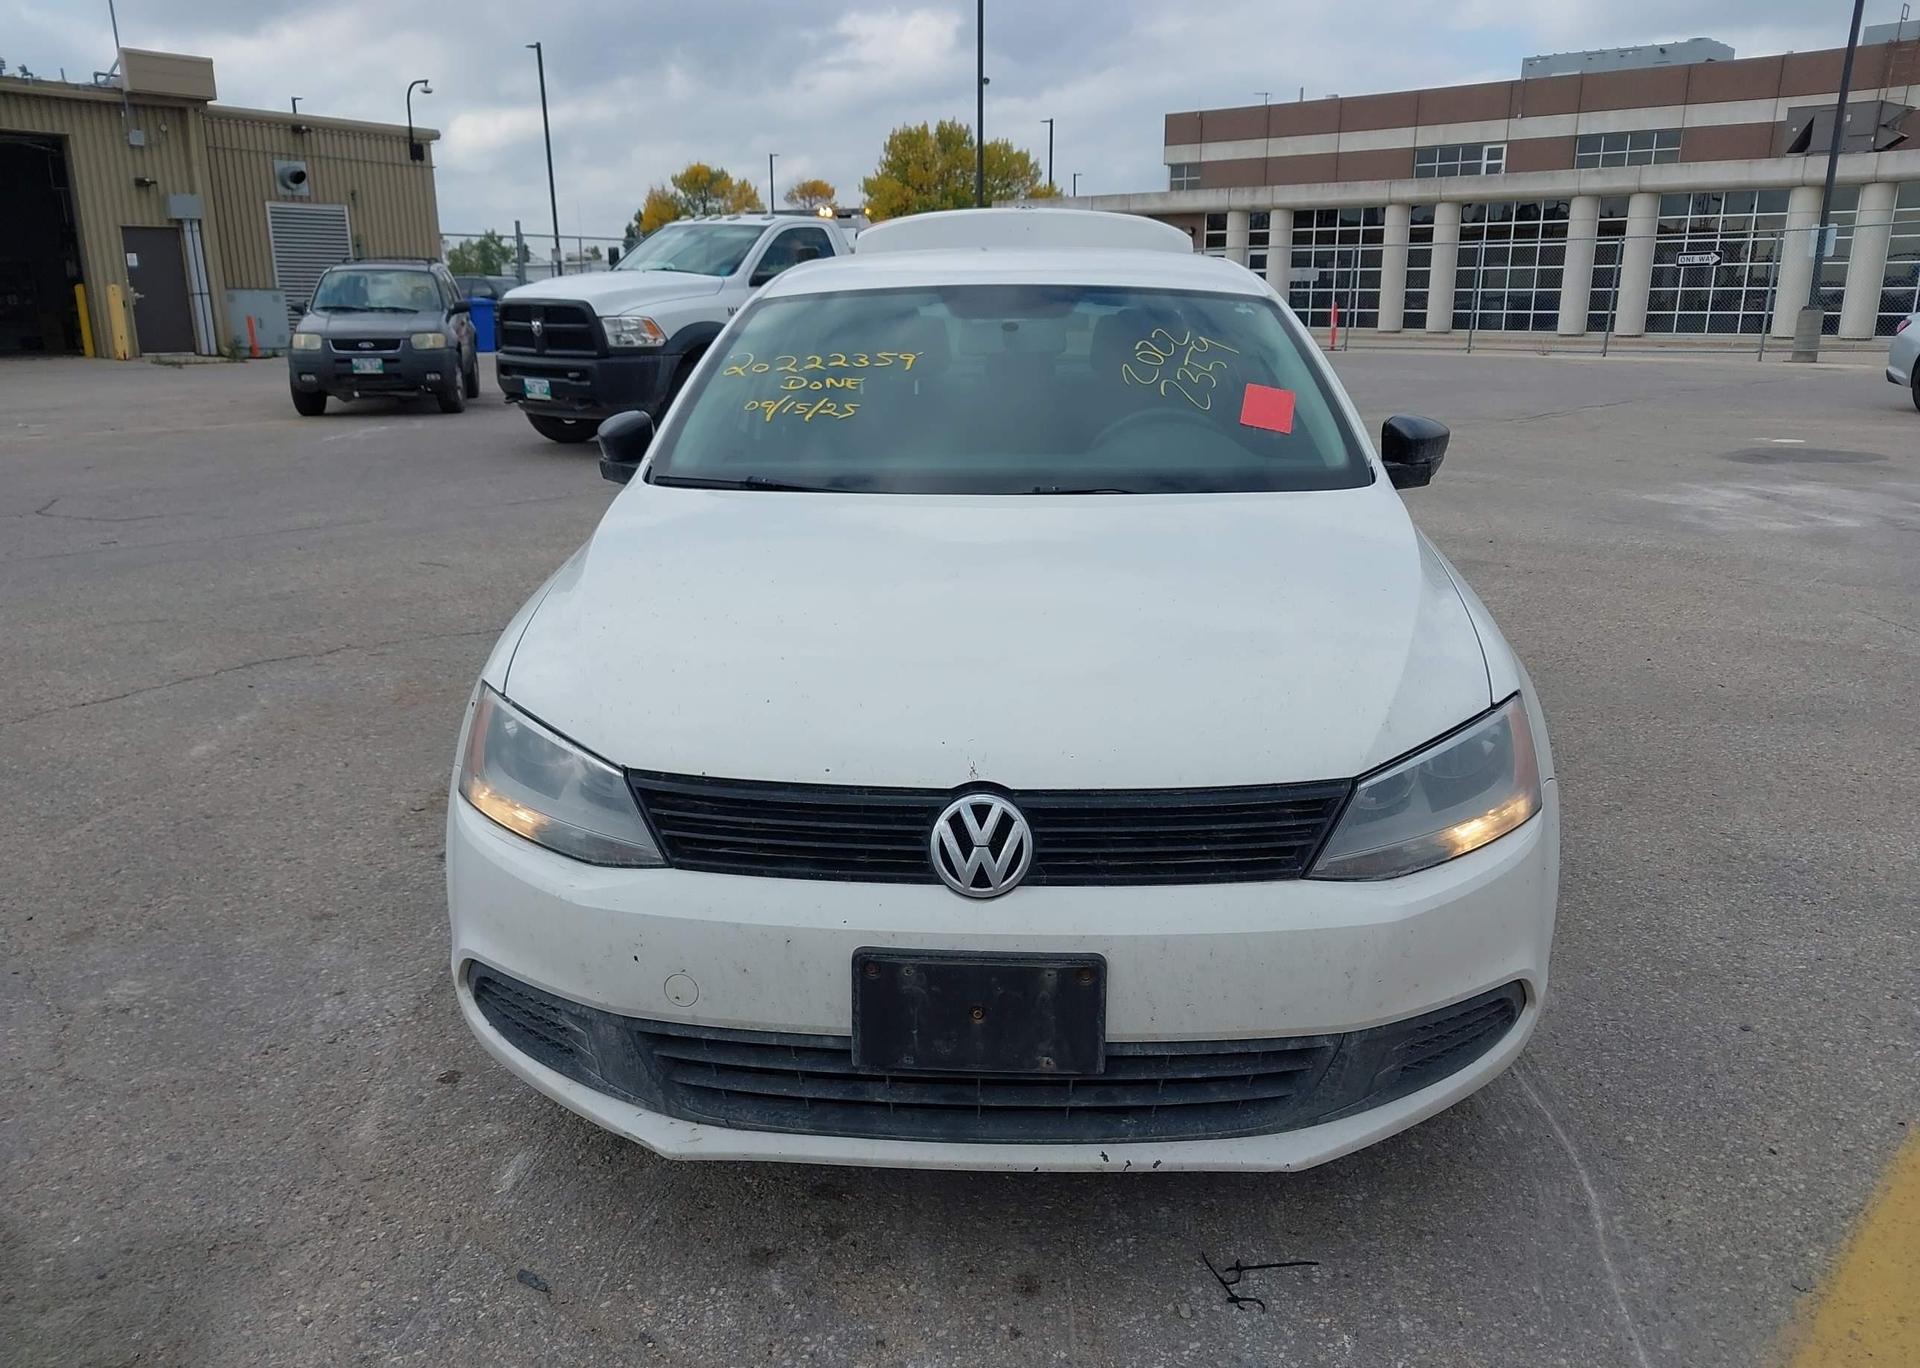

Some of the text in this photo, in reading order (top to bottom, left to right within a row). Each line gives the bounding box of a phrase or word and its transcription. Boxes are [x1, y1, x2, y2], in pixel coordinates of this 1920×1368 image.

[1680, 255, 1716, 264] ONE WAY
[744, 395, 861, 423] 09/15/25
